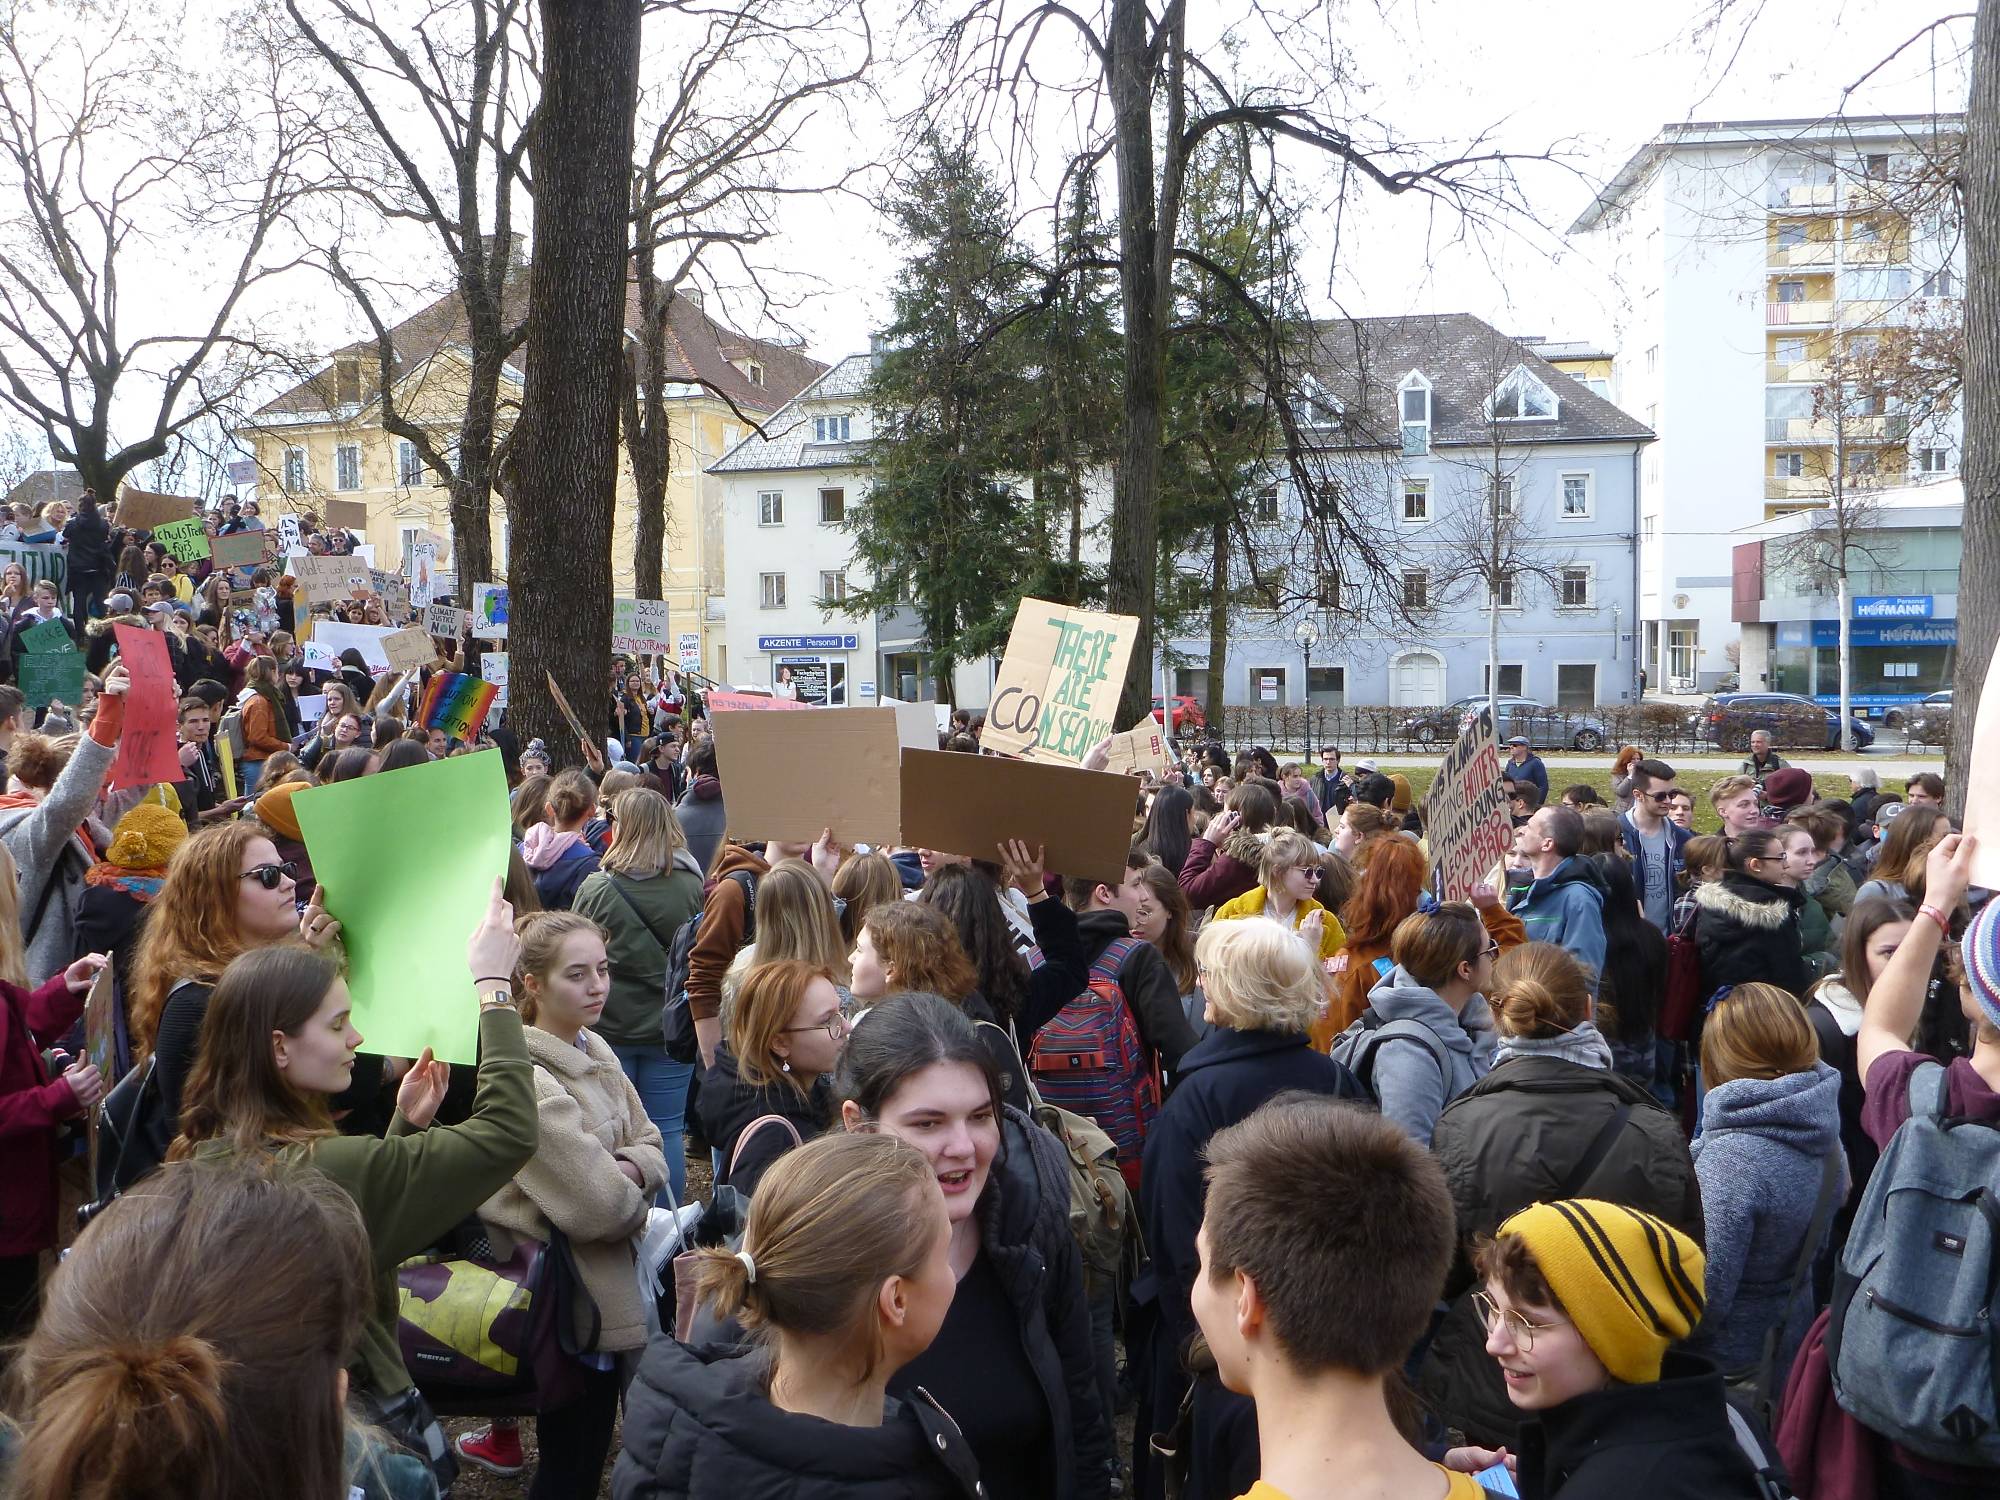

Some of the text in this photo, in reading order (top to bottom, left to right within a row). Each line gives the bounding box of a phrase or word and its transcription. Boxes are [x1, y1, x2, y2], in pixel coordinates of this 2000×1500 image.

[430, 606, 457, 617] CLIMATE
[431, 615, 455, 623] JUSTICE
[1858, 604, 1926, 616] HOFMANN
[431, 621, 457, 636] NOW
[635, 618, 661, 635] Vitae
[763, 637, 838, 647] AKZENTE Personal
[1048, 617, 1117, 680] THERE
[1052, 671, 1097, 711] ARE
[1429, 705, 1493, 822] THIS PLANET IS
[1430, 743, 1500, 857] GETTING HOTTER
[1441, 776, 1506, 858] THAN YOUNG
[1445, 810, 1501, 883] LEONARDO
